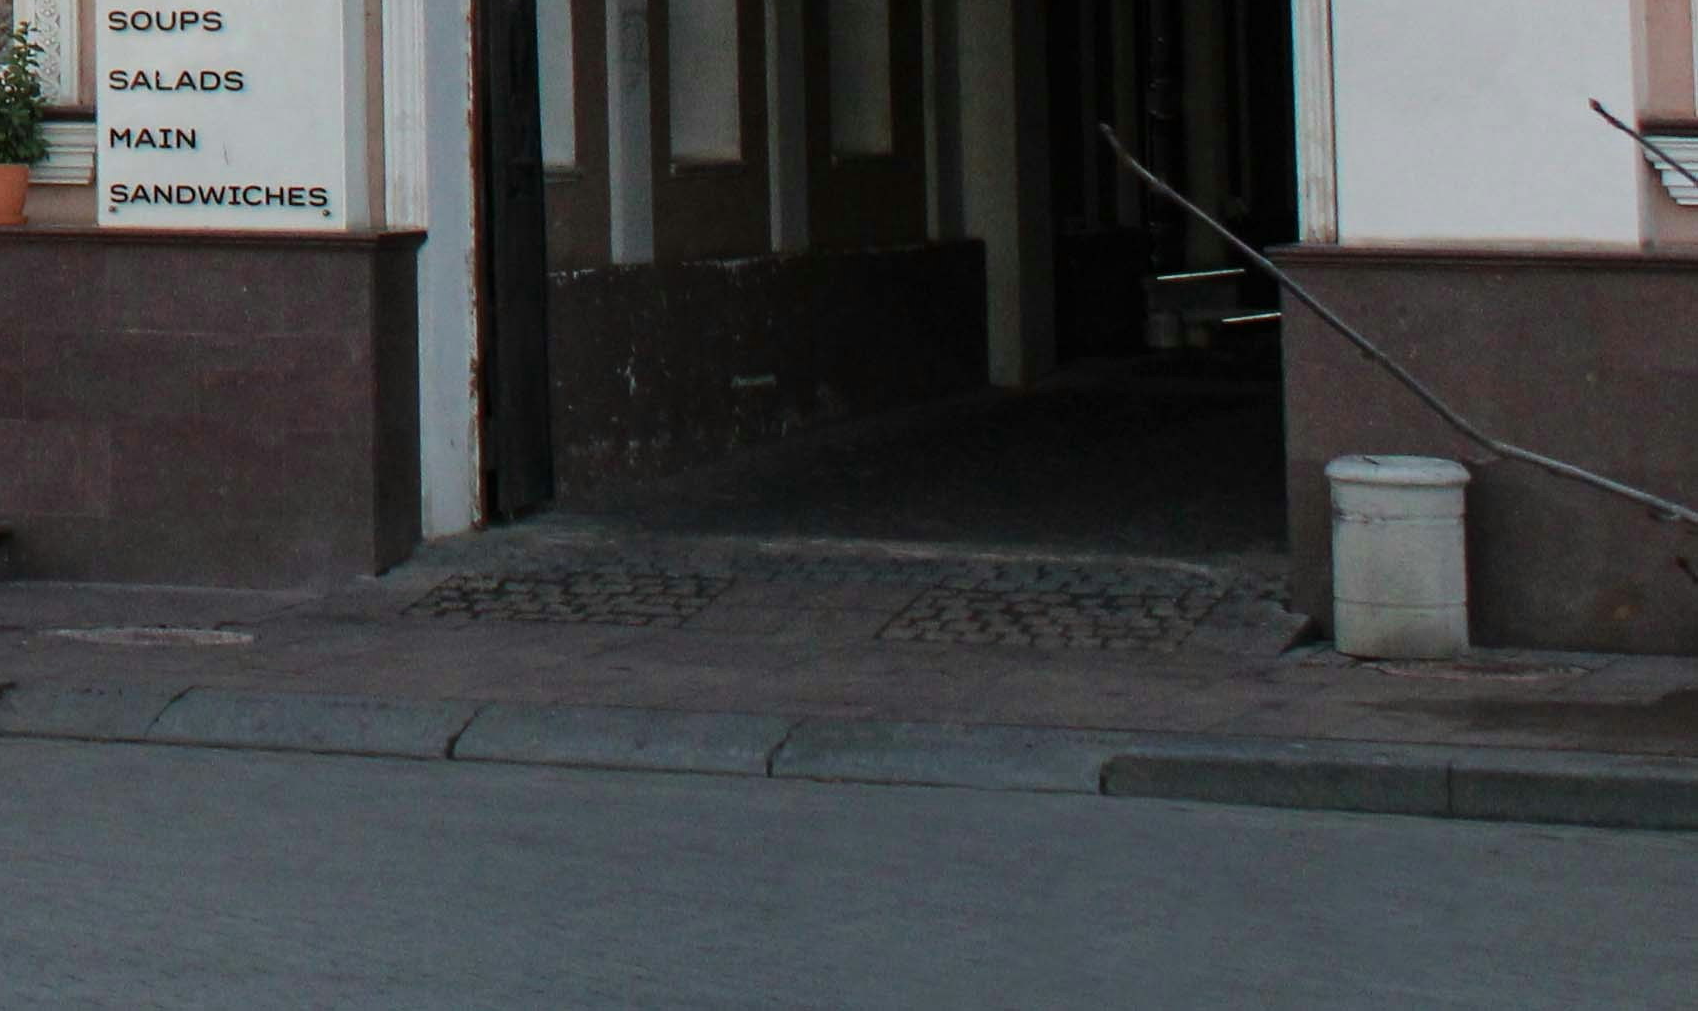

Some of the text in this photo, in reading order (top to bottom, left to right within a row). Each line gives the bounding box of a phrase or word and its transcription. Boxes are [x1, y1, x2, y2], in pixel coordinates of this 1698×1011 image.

[108, 11, 222, 31] SOUPS
[109, 70, 244, 91] SALADS
[109, 128, 196, 149] MAIN
[110, 184, 328, 207] SANDWICHES
